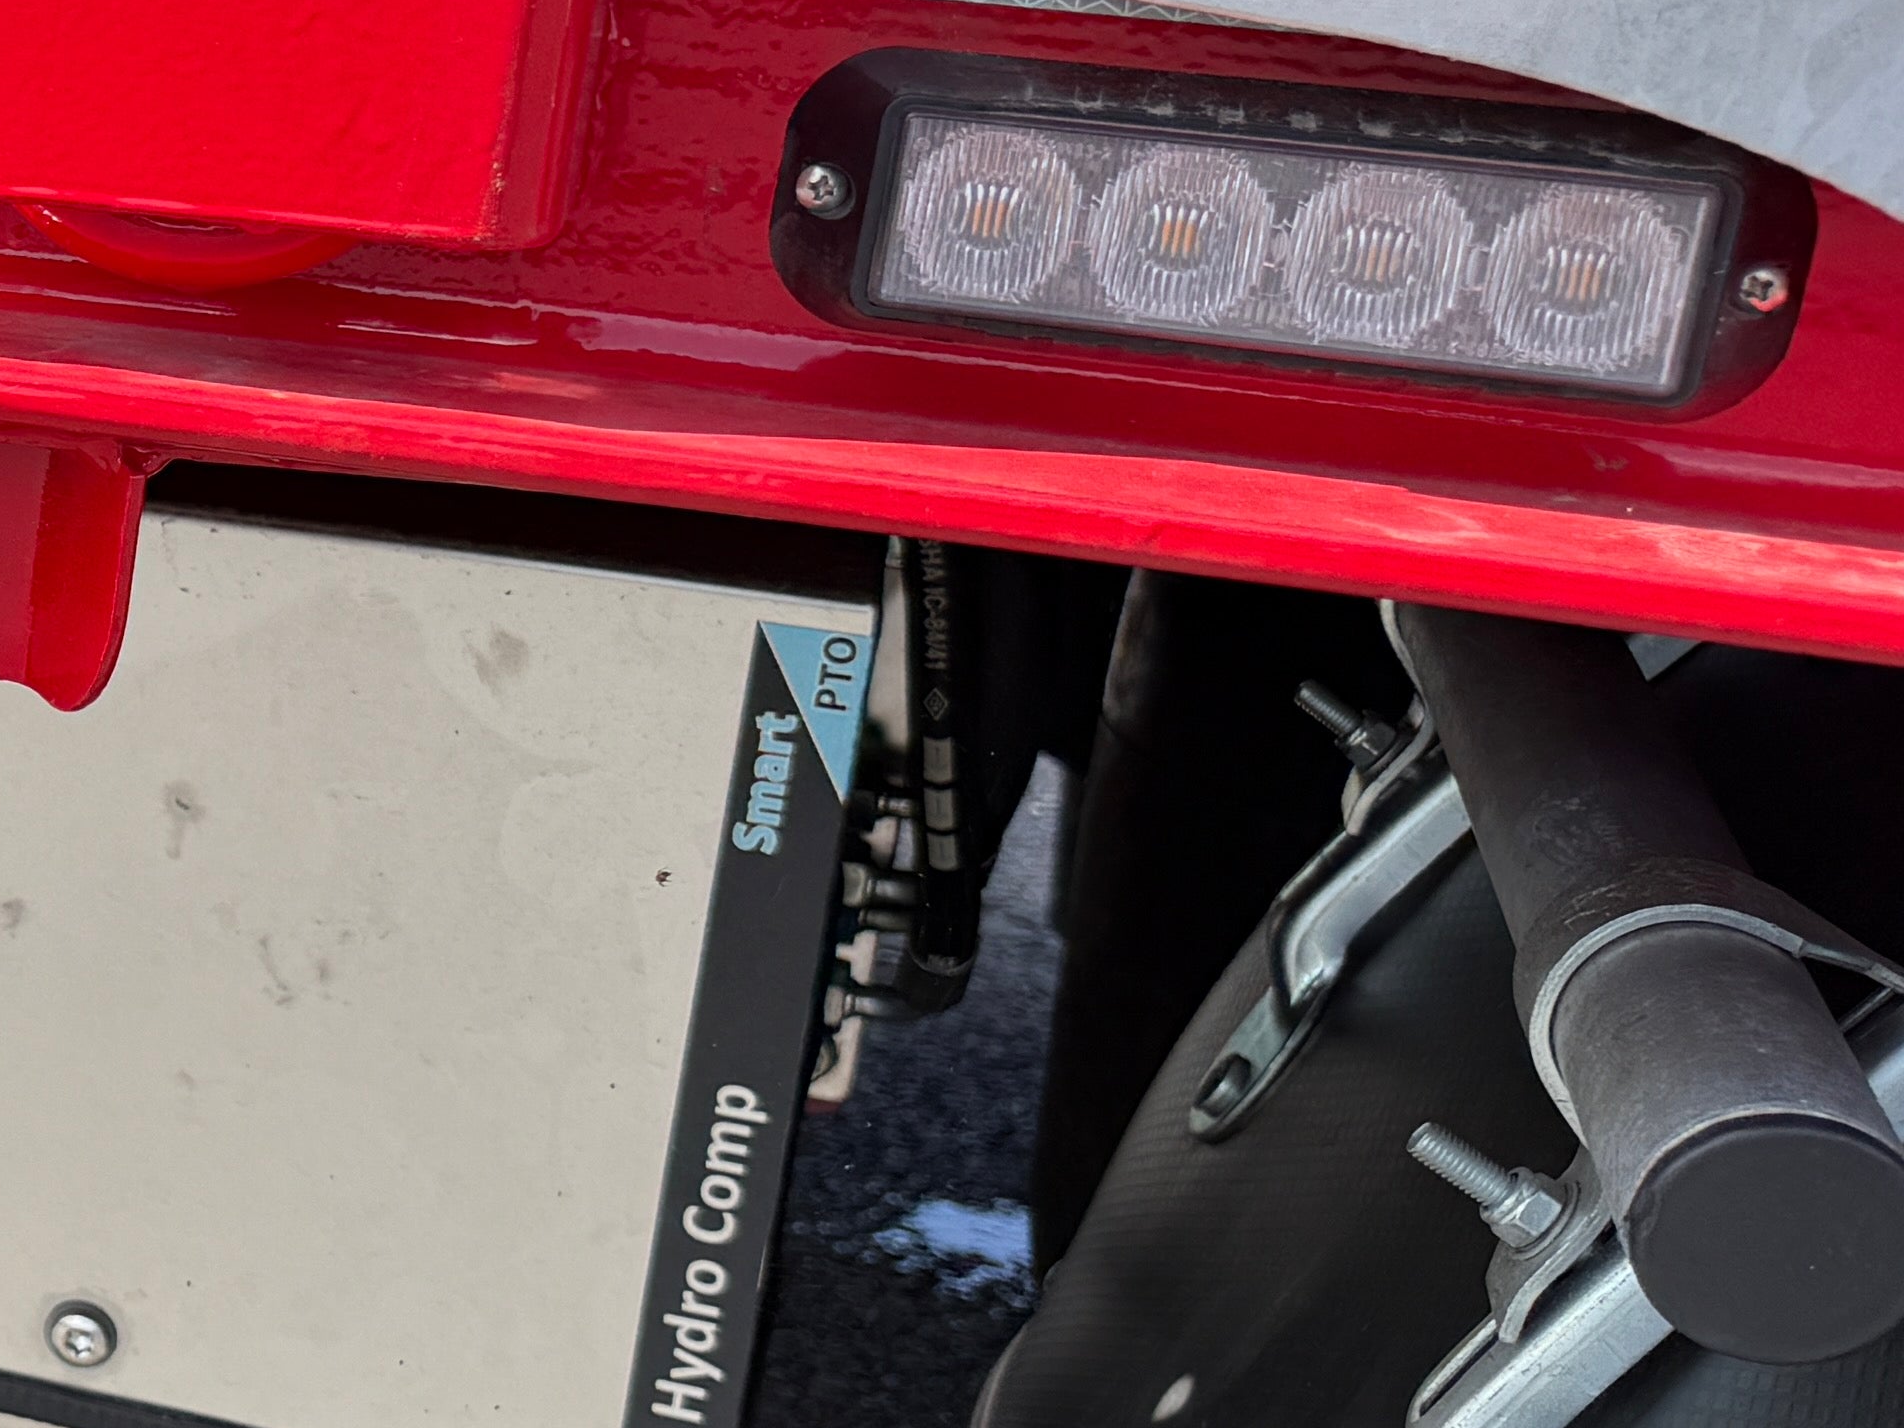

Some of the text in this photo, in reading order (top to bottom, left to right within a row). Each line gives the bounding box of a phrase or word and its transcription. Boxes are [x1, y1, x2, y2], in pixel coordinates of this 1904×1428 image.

[813, 636, 858, 711] PTO
[731, 710, 799, 856] Smart
[651, 1083, 770, 1425] Hydro Comp
